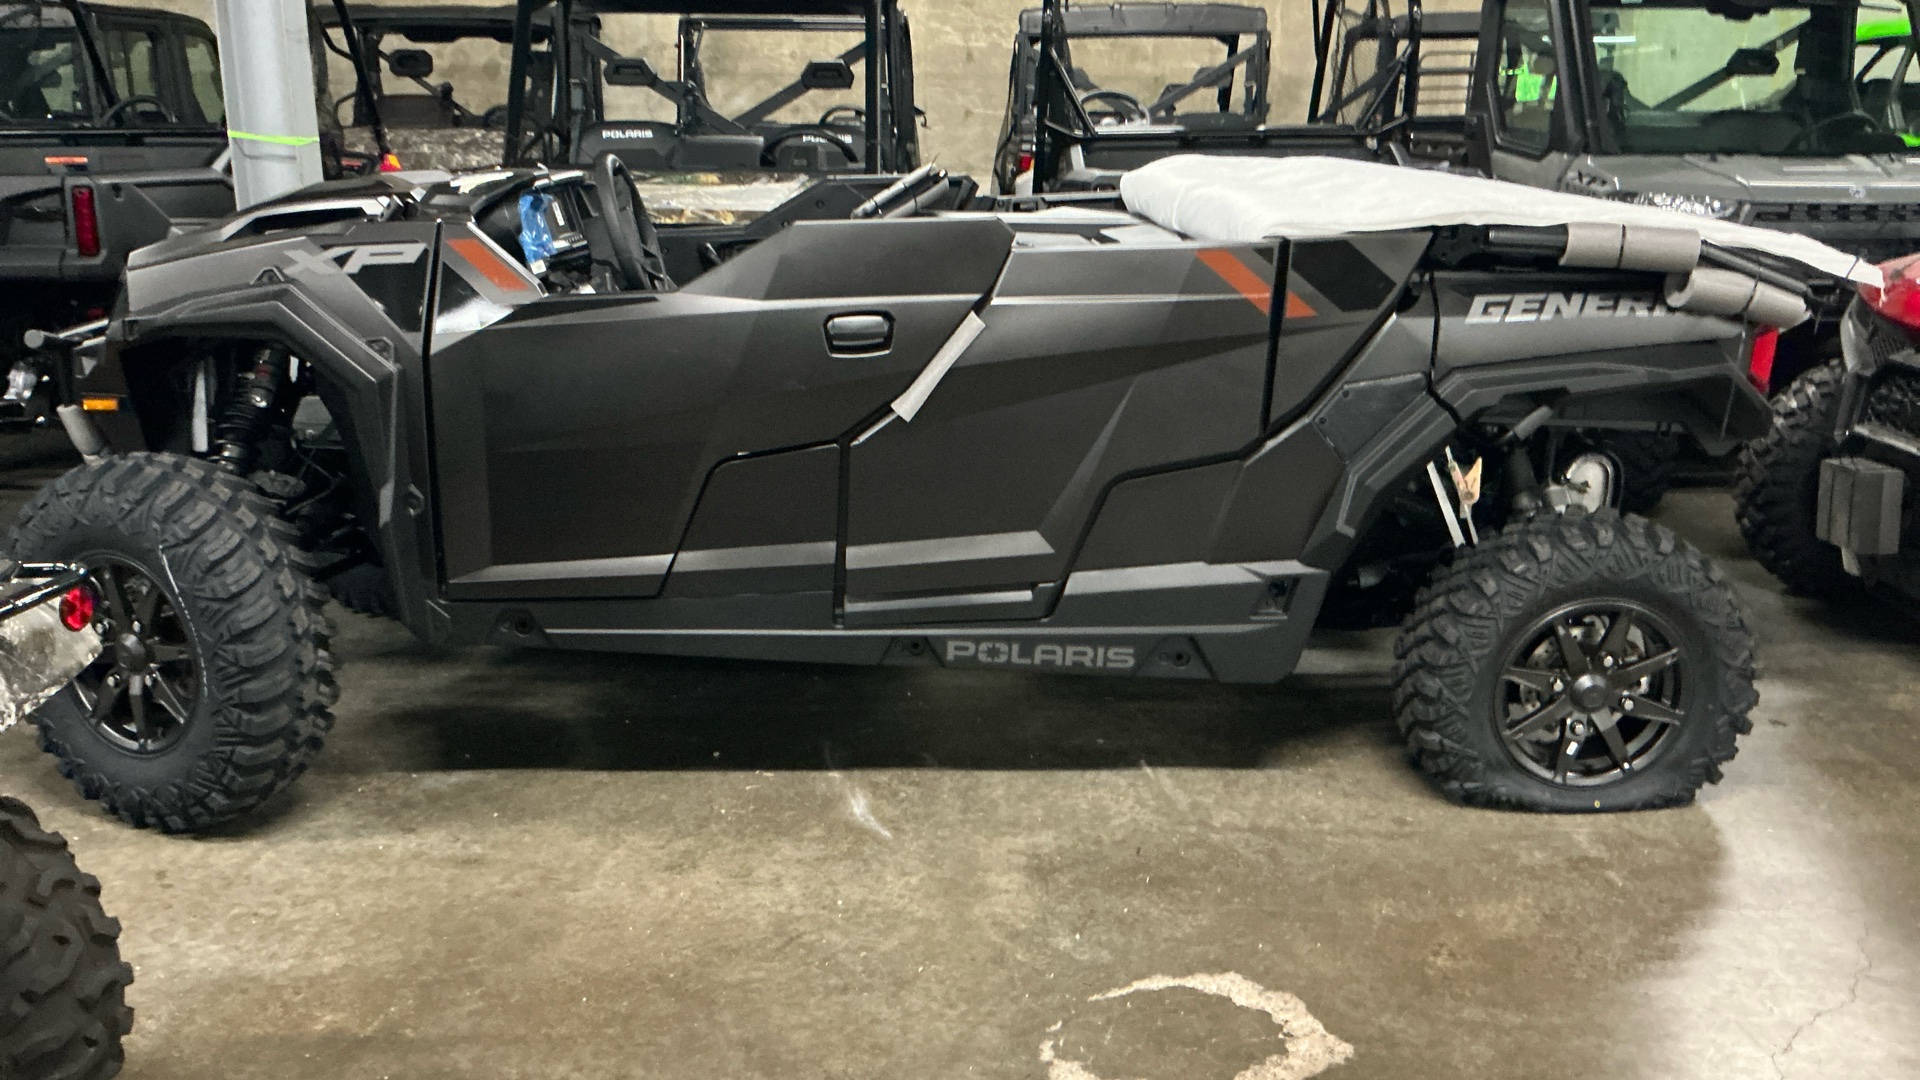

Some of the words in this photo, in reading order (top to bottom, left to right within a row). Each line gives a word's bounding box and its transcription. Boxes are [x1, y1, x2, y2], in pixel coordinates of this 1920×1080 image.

[602, 129, 653, 139] POLARIS
[283, 243, 427, 275] XP
[946, 640, 1135, 668] POLARIS
